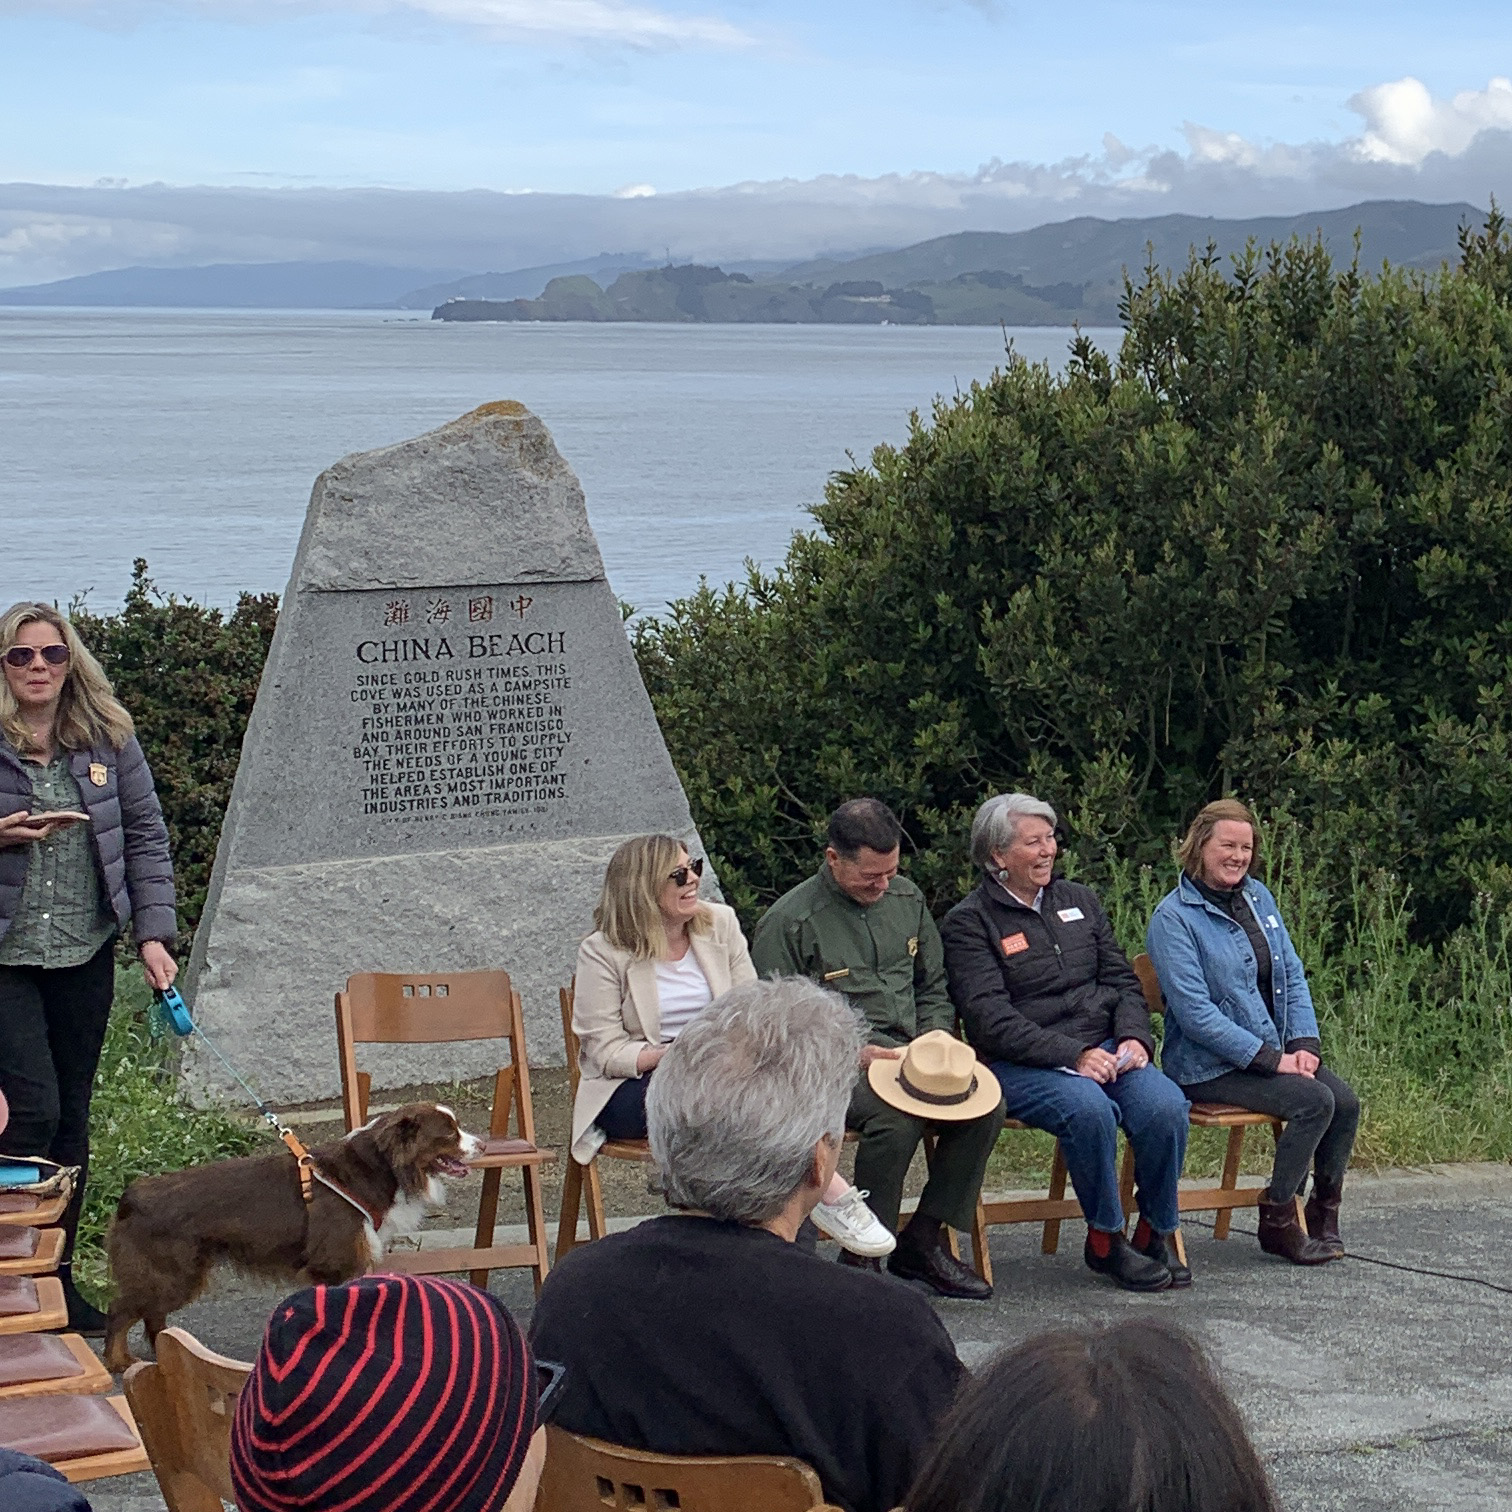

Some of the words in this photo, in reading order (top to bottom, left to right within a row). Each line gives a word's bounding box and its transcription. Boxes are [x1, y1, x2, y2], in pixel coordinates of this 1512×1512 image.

[356, 638, 455, 664] CHINA
[467, 631, 566, 659] BEACH
[357, 673, 397, 686] SINCE
[404, 671, 439, 684] GOLD
[446, 668, 482, 681] RUSH
[536, 663, 566, 676] THIS
[350, 688, 386, 702] COVE
[391, 686, 421, 699] WAS
[426, 684, 462, 697] USED
[468, 682, 485, 695] AS
[490, 682, 498, 693] A
[504, 677, 572, 692] CAMPSITE
[373, 703, 390, 714] BY
[396, 700, 435, 713] MANY
[440, 698, 457, 710] OF
[463, 696, 489, 708] THE
[493, 692, 552, 707] CHINESE
[362, 713, 444, 729] FISHERMEN
[451, 710, 482, 724] WHO
[487, 706, 544, 721] WORKED
[549, 705, 562, 717] IN
[361, 731, 389, 744] AND
[395, 727, 451, 741] AROUND
[456, 725, 482, 738] SAN
[490, 718, 563, 735] FRANCISCO
[353, 745, 379, 759] BAY
[385, 742, 428, 756] THEIR
[433, 737, 494, 753] EFFORTS
[499, 735, 516, 748] TO
[522, 732, 572, 747] SUPPLY
[363, 759, 391, 772] THE
[396, 755, 442, 769] NEEDS
[447, 753, 463, 766] OF
[470, 752, 478, 763] A
[483, 748, 528, 763] YOUNG
[534, 746, 564, 760] CITY
[370, 770, 426, 785] HELPED
[430, 764, 504, 781] ESTABLISH
[510, 762, 536, 775] ONE
[540, 760, 557, 772] OF
[361, 787, 389, 800] THE
[447, 779, 485, 794] MOST
[490, 773, 567, 790] IMPORTANT
[364, 796, 448, 814] INDUSTRIES
[453, 794, 480, 807] AND
